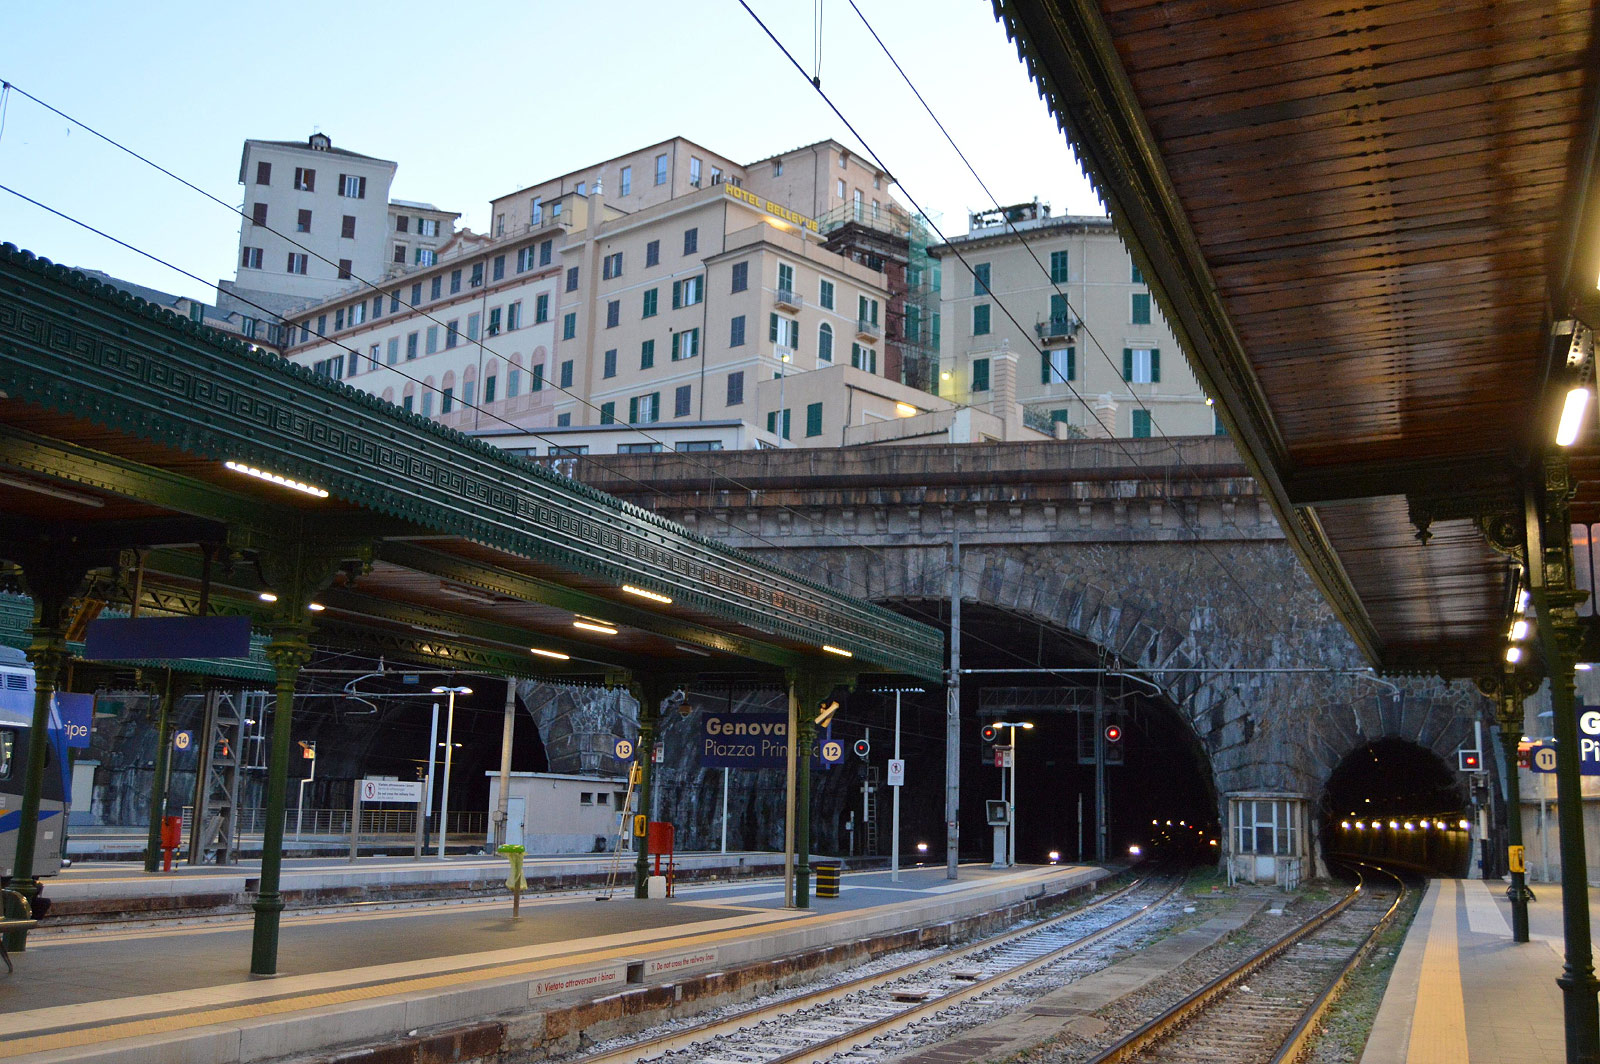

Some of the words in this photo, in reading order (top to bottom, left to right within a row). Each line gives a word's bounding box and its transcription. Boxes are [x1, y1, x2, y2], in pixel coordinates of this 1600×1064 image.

[725, 183, 762, 208] HOTEL
[766, 201, 818, 232] BELLEVUE
[706, 717, 786, 736] Genova
[178, 736, 187, 745] 14
[704, 739, 755, 757] Piazza
[619, 745, 630, 754] 13
[825, 747, 838, 757] 12
[1541, 754, 1553, 765] 11
[656, 962, 662, 970] Do
[663, 961, 671, 969] not
[671, 959, 682, 968] cross
[690, 955, 705, 964] railway
[544, 982, 564, 992] Vietato
[565, 976, 597, 989] attraversare
[601, 969, 616, 981] binari
